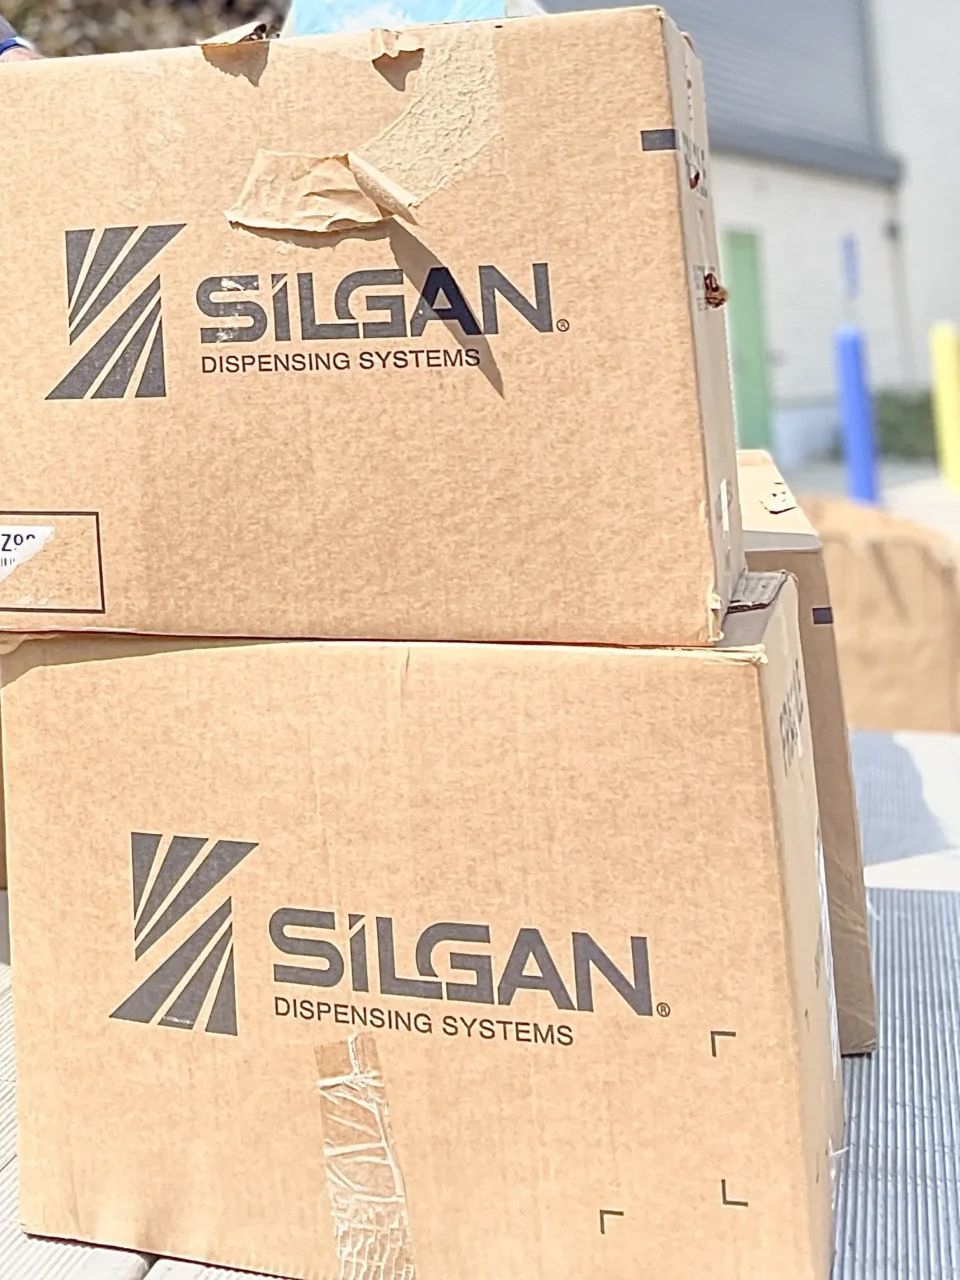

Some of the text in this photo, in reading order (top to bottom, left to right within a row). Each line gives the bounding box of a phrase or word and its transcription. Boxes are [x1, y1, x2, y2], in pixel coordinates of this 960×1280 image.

[201, 348, 481, 373] DISPENSING SYSTEMS
[274, 996, 574, 1046] DISPENSING SYSTEMS
